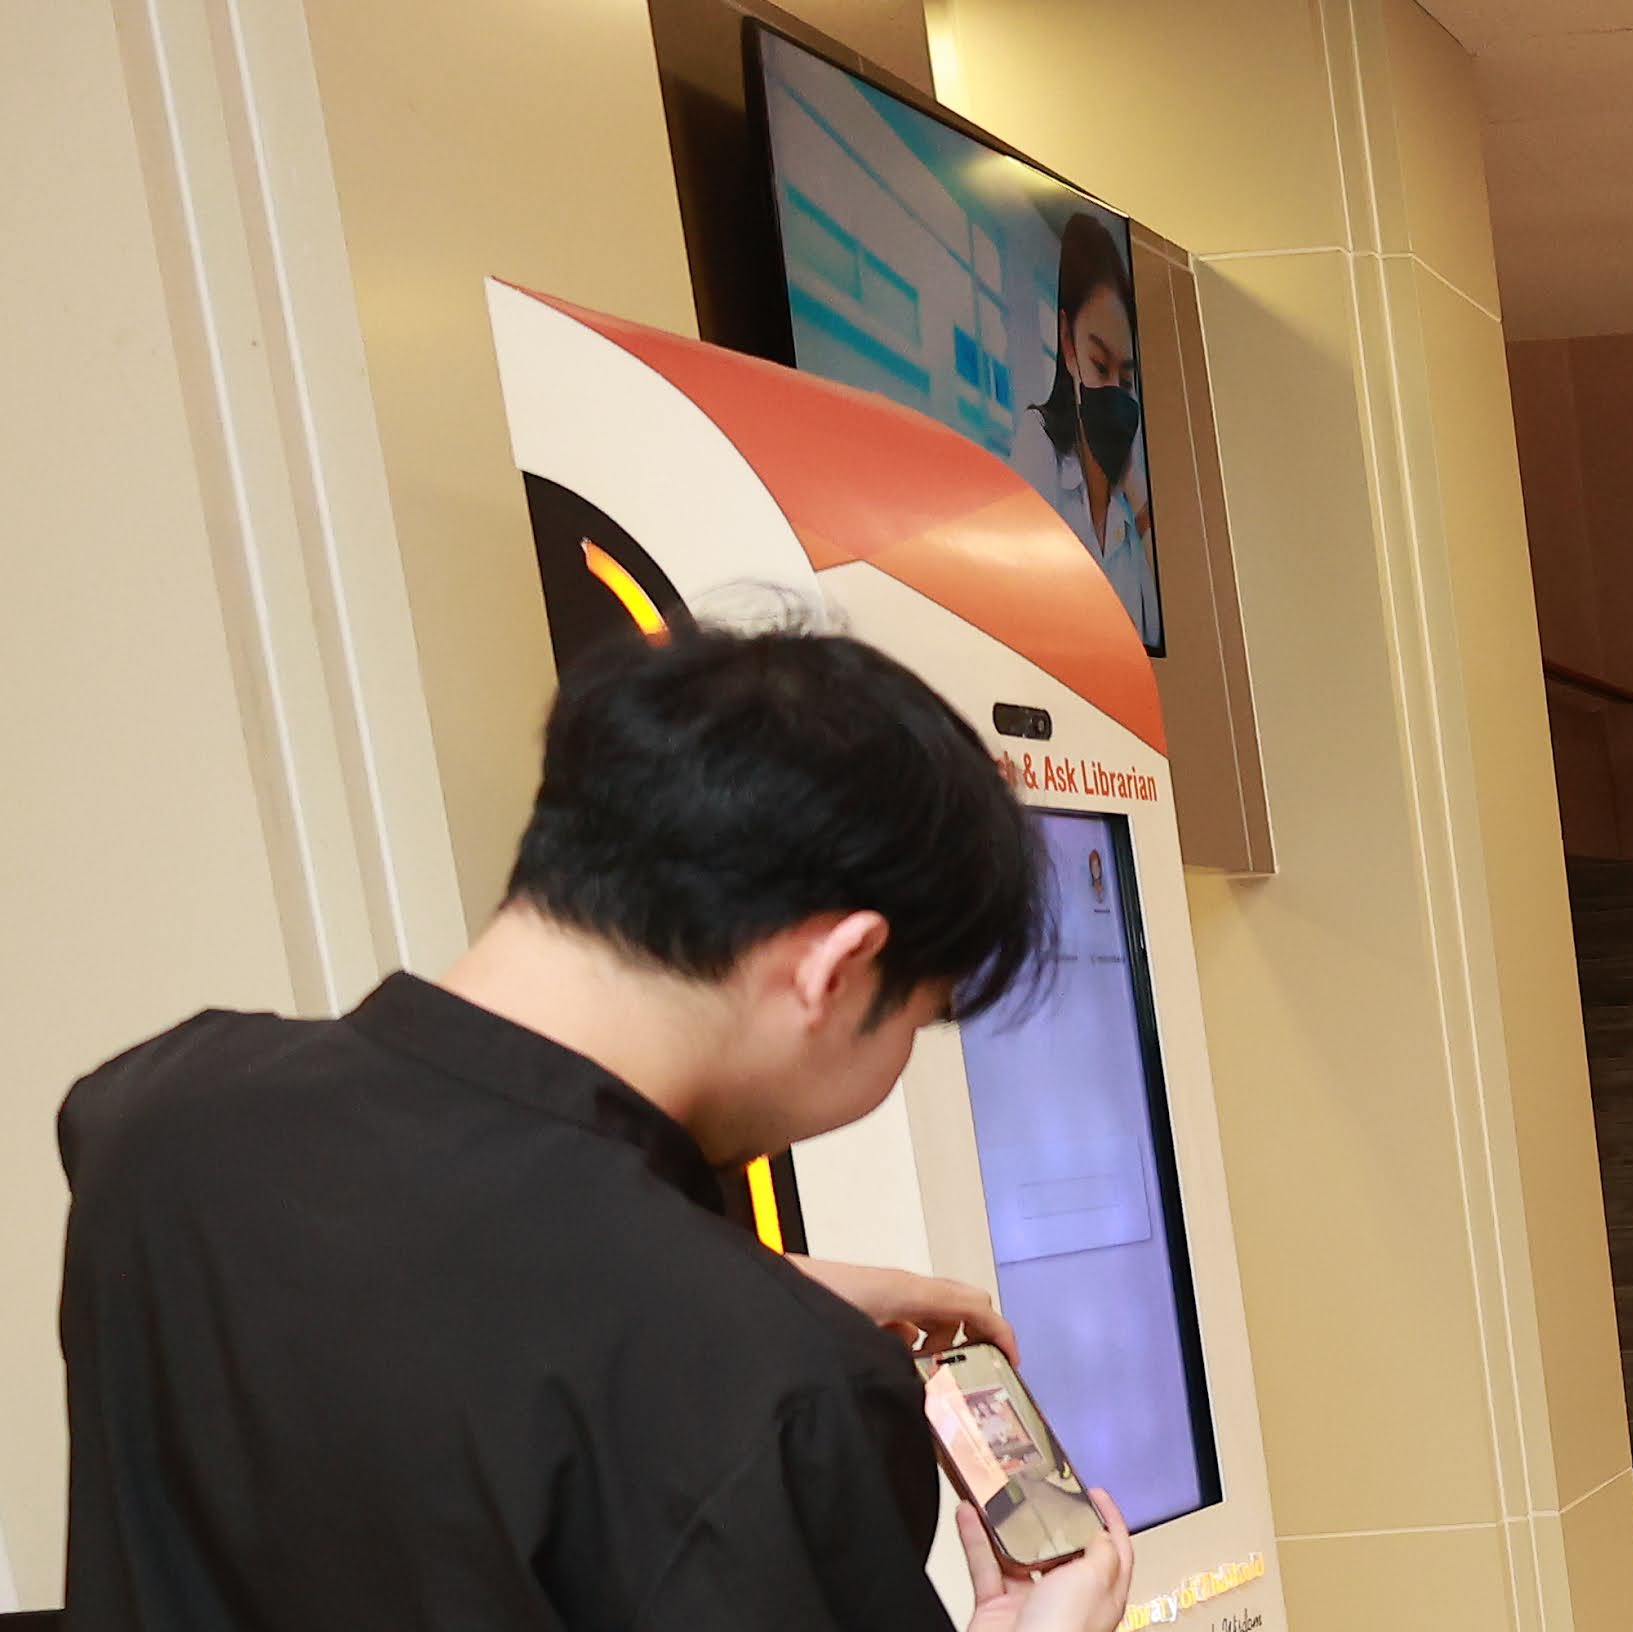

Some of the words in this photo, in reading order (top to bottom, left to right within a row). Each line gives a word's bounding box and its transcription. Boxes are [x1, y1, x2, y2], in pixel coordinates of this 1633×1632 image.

[1023, 753, 1039, 789] &
[1044, 756, 1078, 793] Ask
[1080, 760, 1158, 801] Librarian
